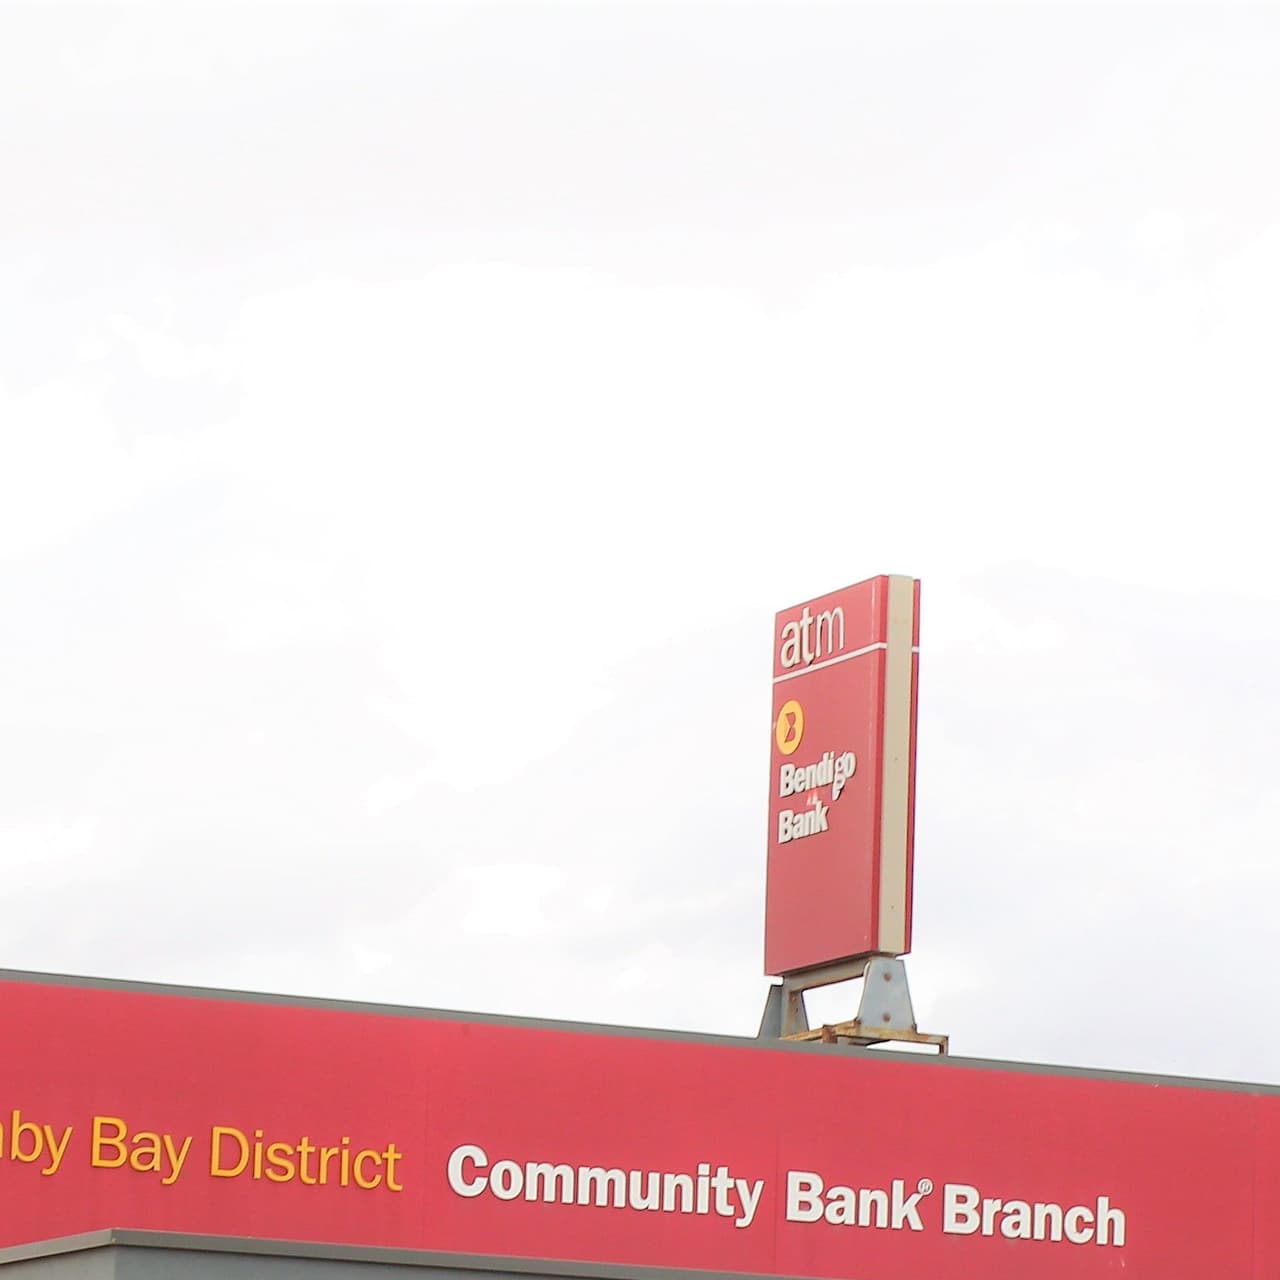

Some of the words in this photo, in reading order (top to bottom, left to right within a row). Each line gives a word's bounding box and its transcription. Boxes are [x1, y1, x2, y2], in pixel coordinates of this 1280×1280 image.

[780, 605, 845, 669] atm
[779, 749, 856, 801] Bendigo
[778, 800, 829, 844] Bank
[91, 1115, 192, 1185] Bay
[210, 1126, 403, 1192] District
[446, 1143, 765, 1228] Community
[942, 1182, 1127, 1247] Branch
